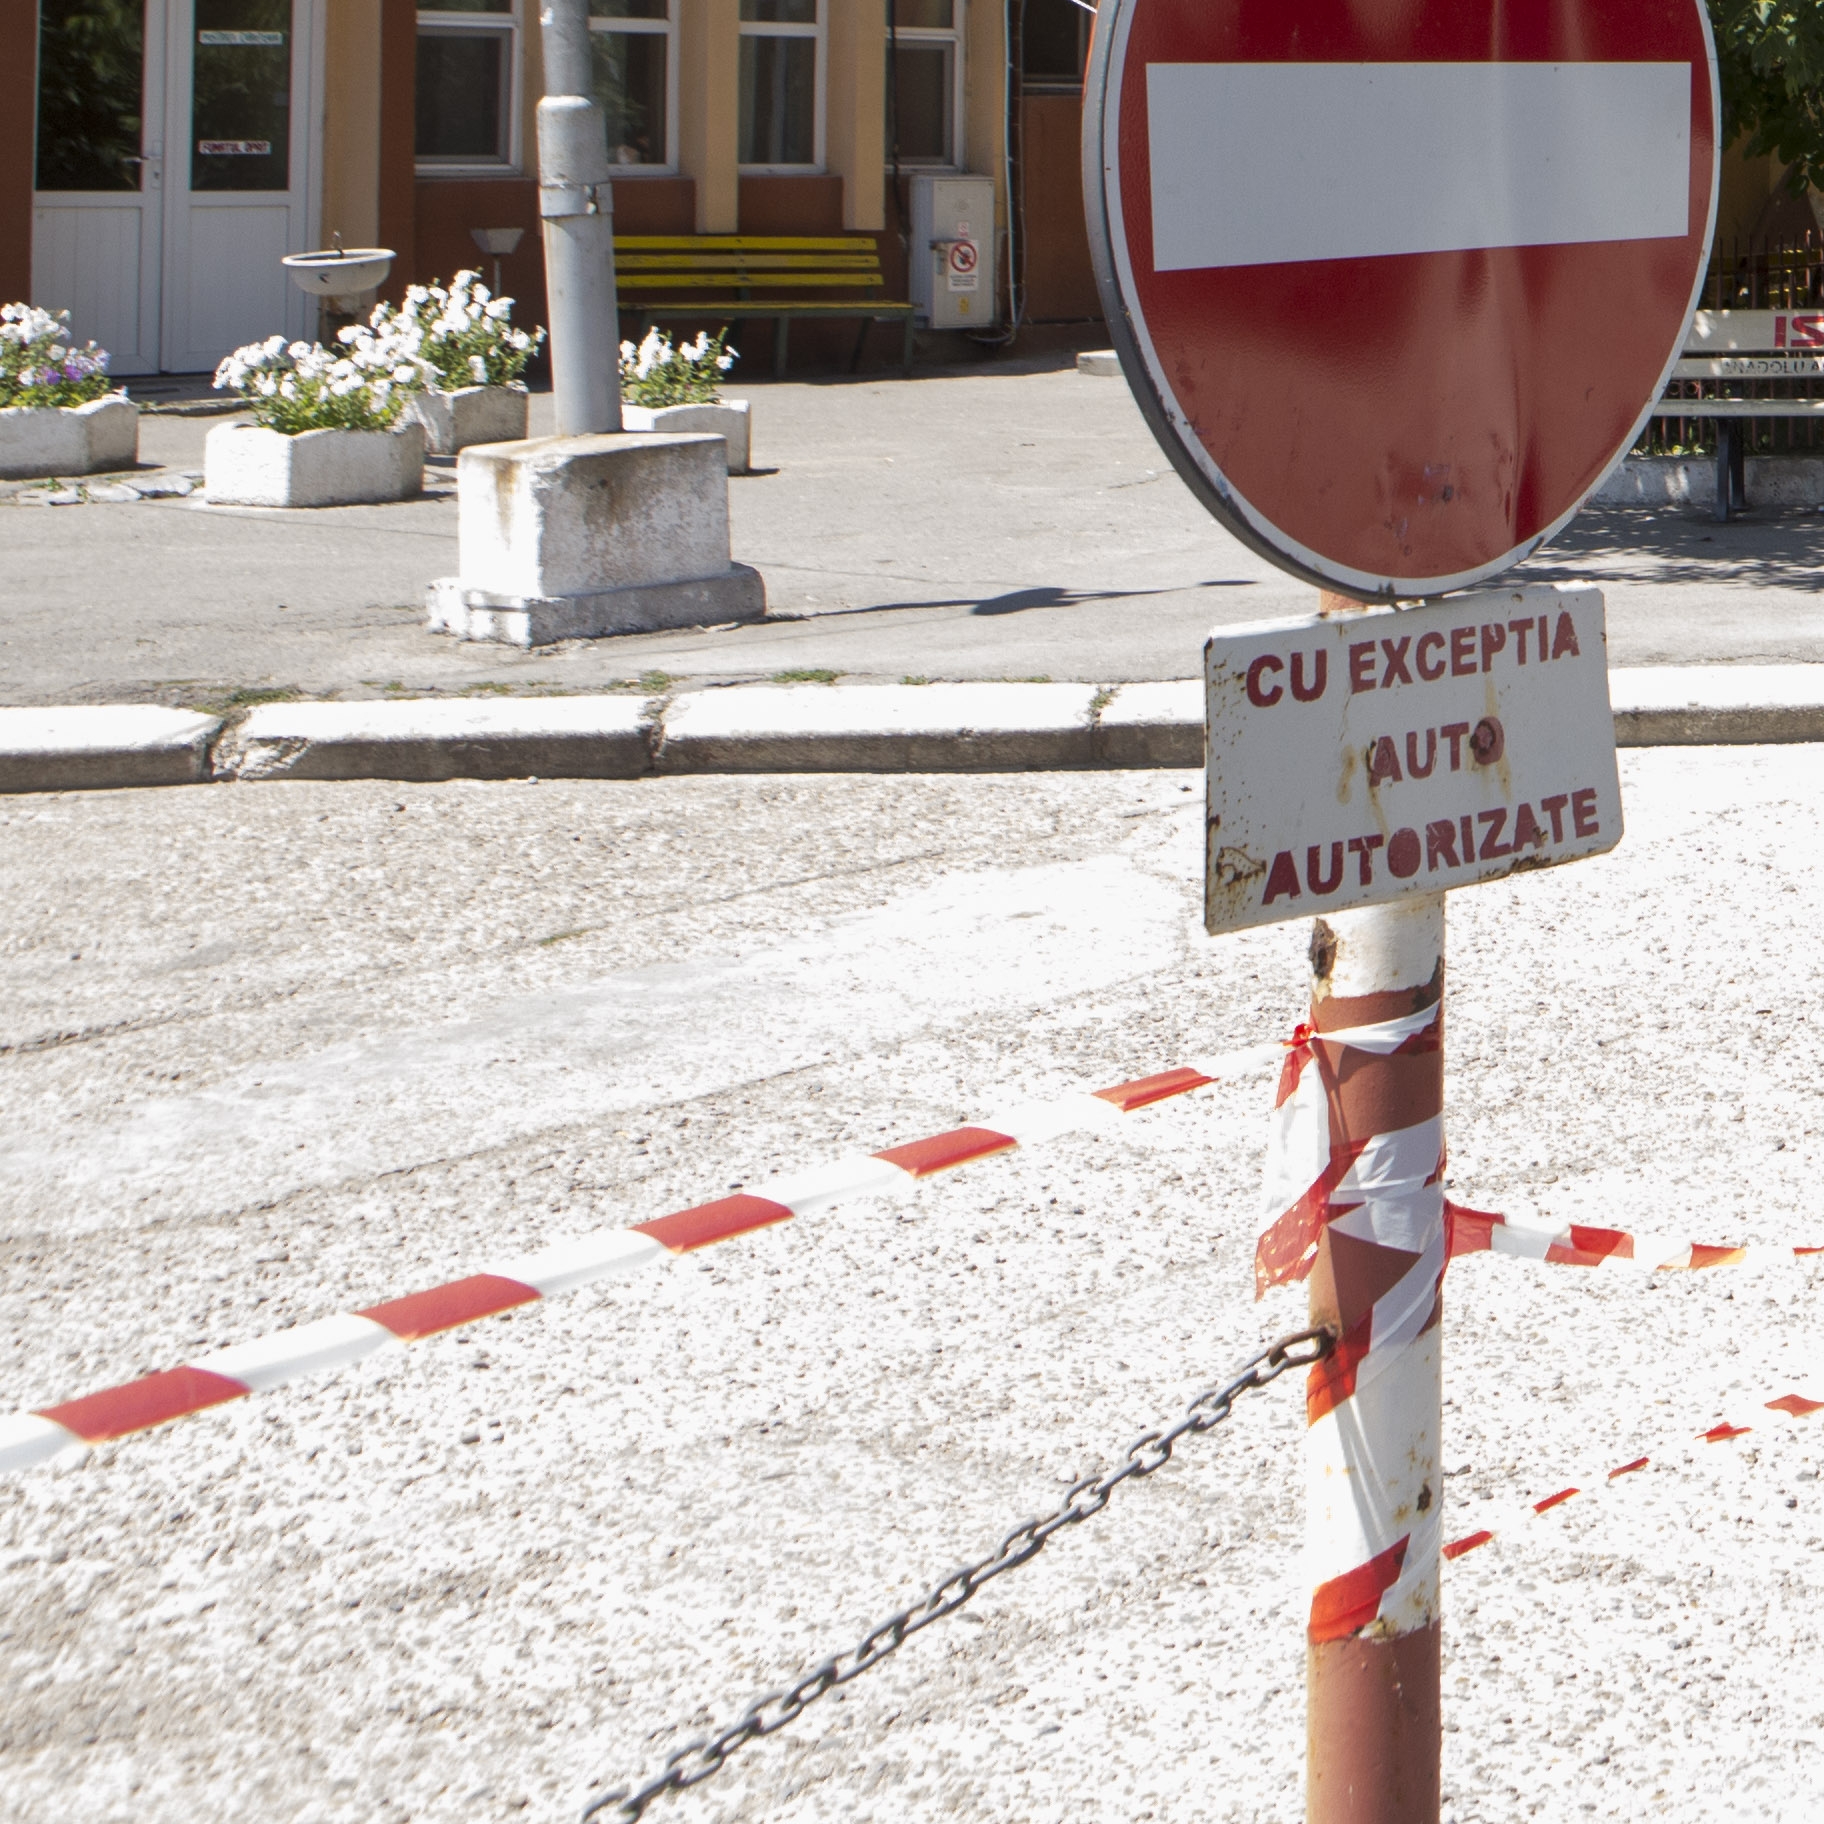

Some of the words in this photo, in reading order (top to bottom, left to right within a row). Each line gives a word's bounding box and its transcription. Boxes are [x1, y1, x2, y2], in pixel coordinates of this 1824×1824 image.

[1246, 648, 1328, 708] CU
[1349, 611, 1580, 695] EXCEPTIA
[1369, 715, 1505, 788] AUTO
[1261, 787, 1600, 906] AUTORIZATE
